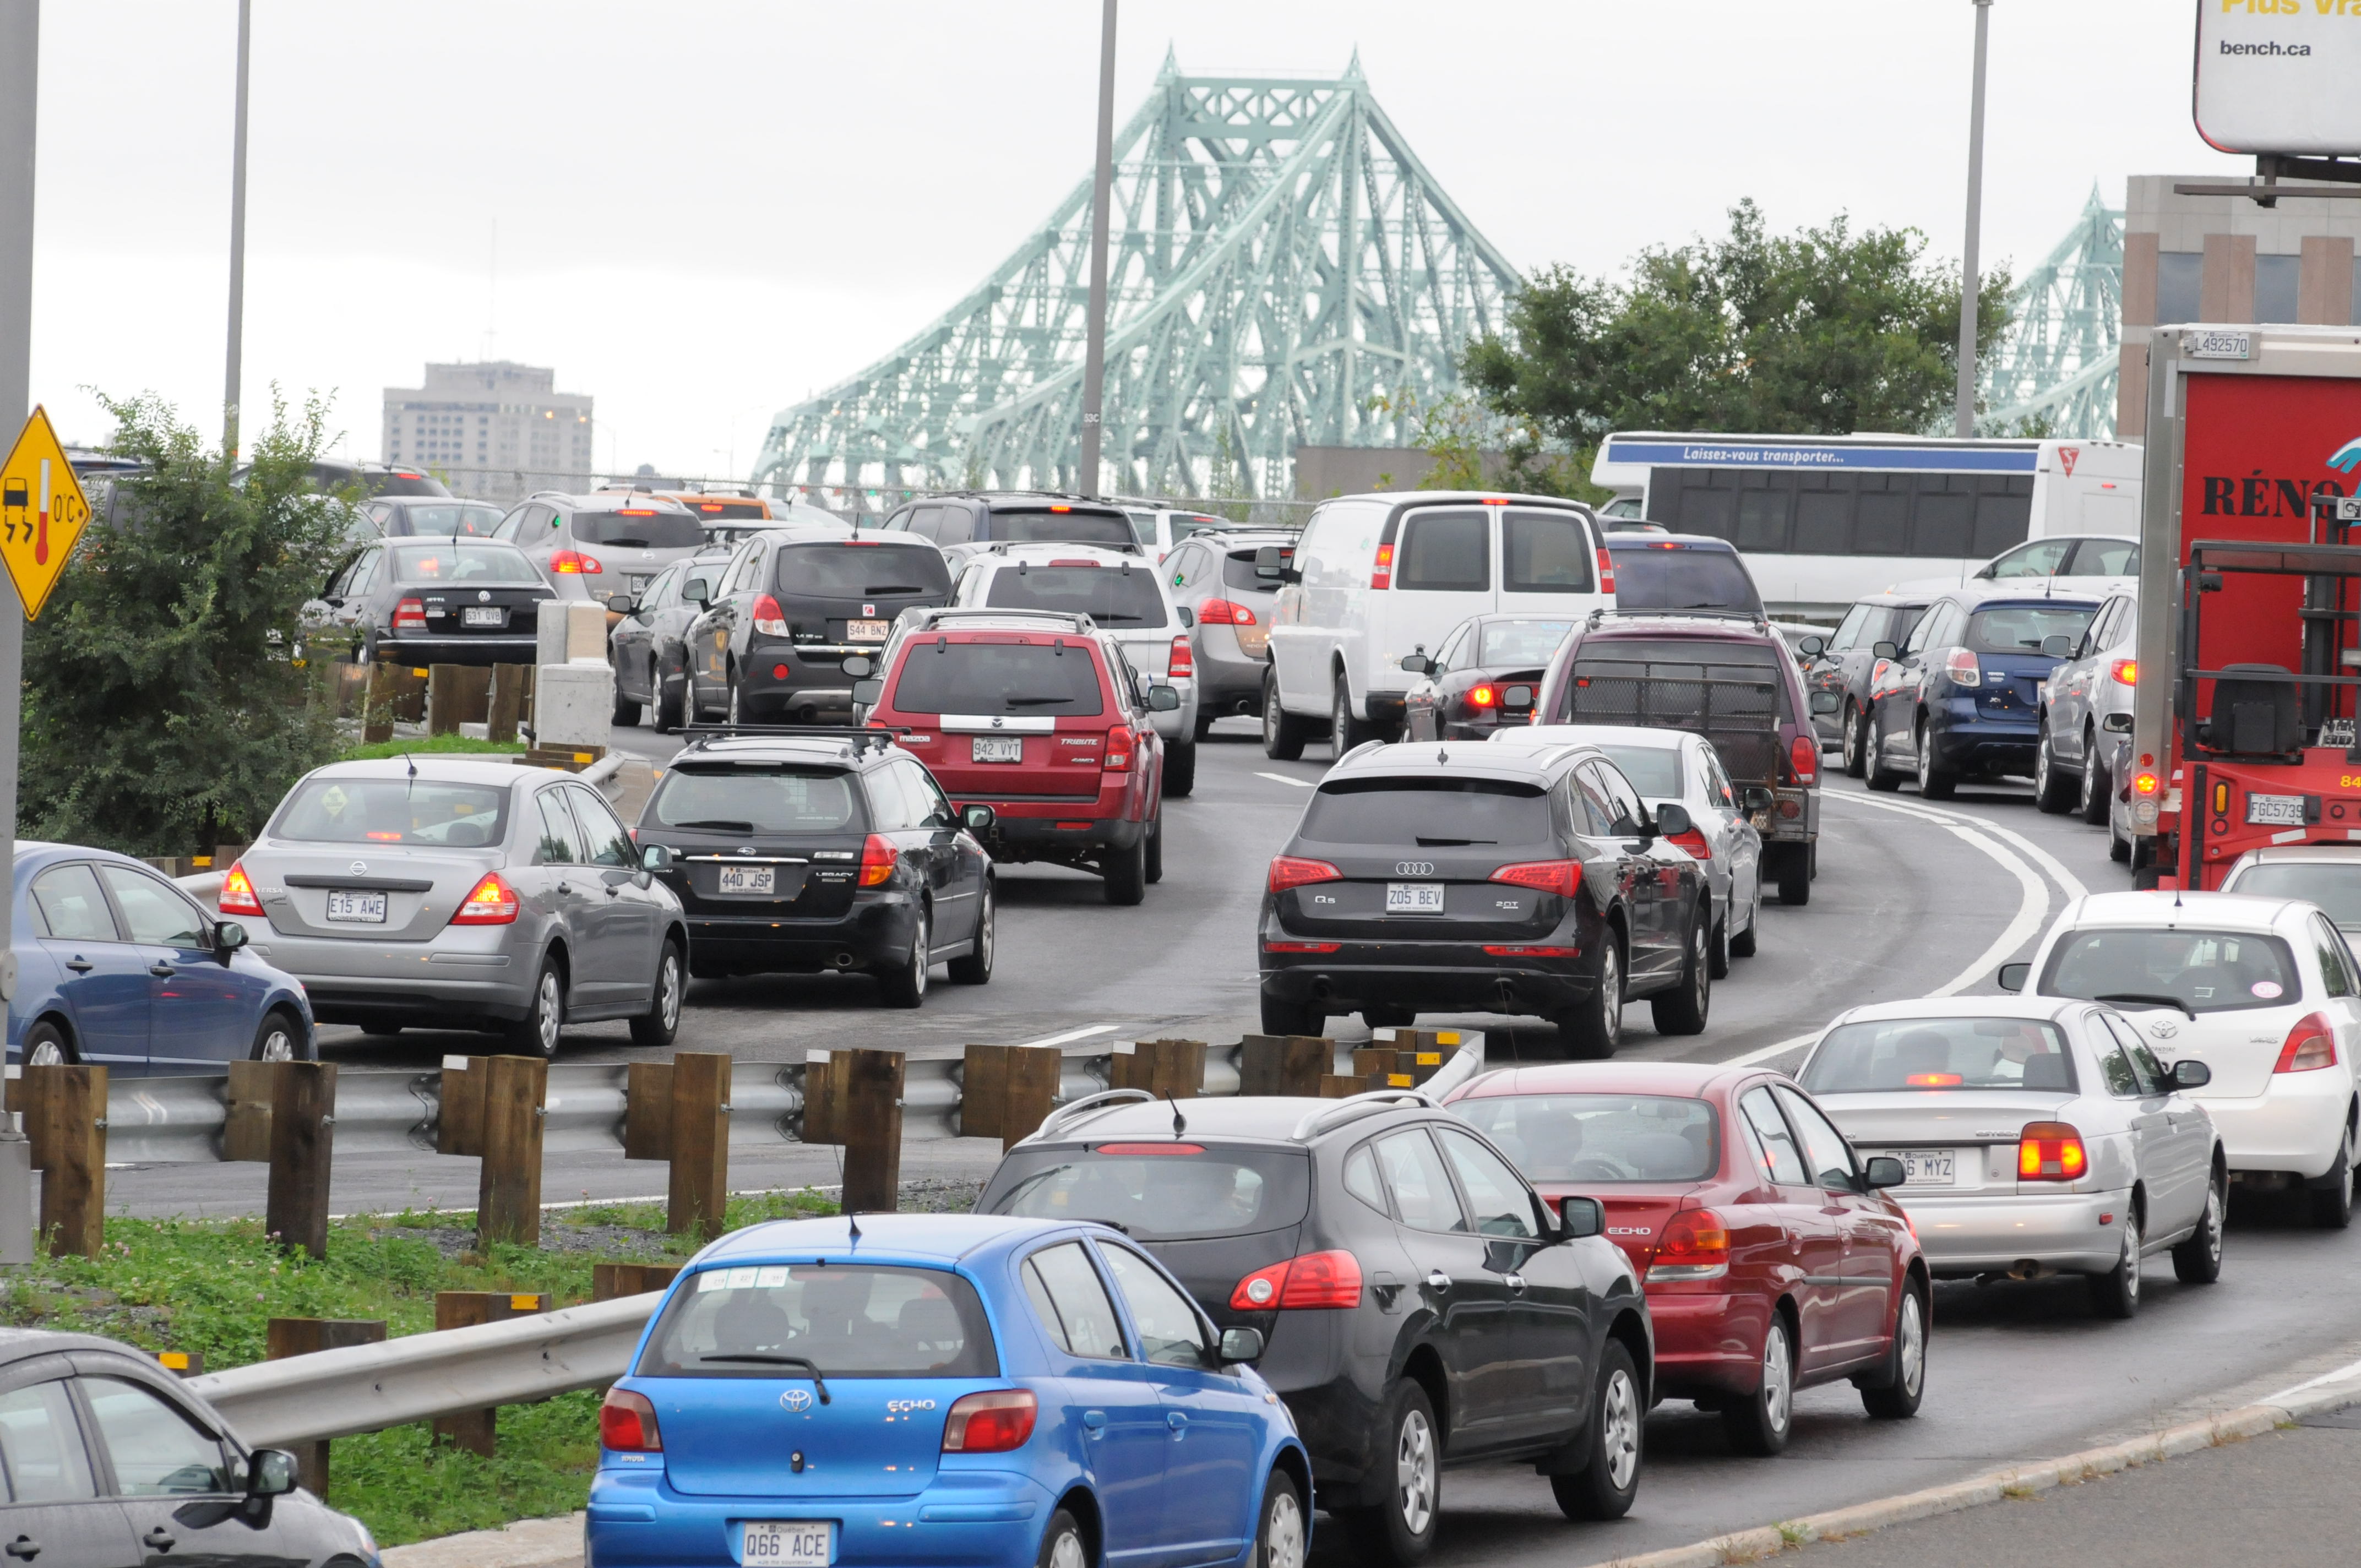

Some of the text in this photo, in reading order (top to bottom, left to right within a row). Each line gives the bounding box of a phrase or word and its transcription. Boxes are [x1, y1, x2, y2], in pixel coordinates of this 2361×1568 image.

[2221, 40, 2310, 56] bench.ca
[2195, 337, 2248, 352] L492570
[1684, 447, 1759, 461] Laissez-vous
[466, 611, 481, 620] 531
[871, 626, 886, 635] BNZ
[975, 743, 1019, 755] 942 VYT
[2251, 802, 2303, 818] FGC5739
[722, 873, 771, 887] 440 JSP
[1315, 895, 1336, 903] Q5
[1419, 891, 1441, 904] BEV
[331, 899, 383, 914] E15 AWE
[1924, 1159, 1951, 1176] MYZ
[887, 1400, 935, 1410] ECHO
[747, 1534, 825, 1556] Q66 ACE
